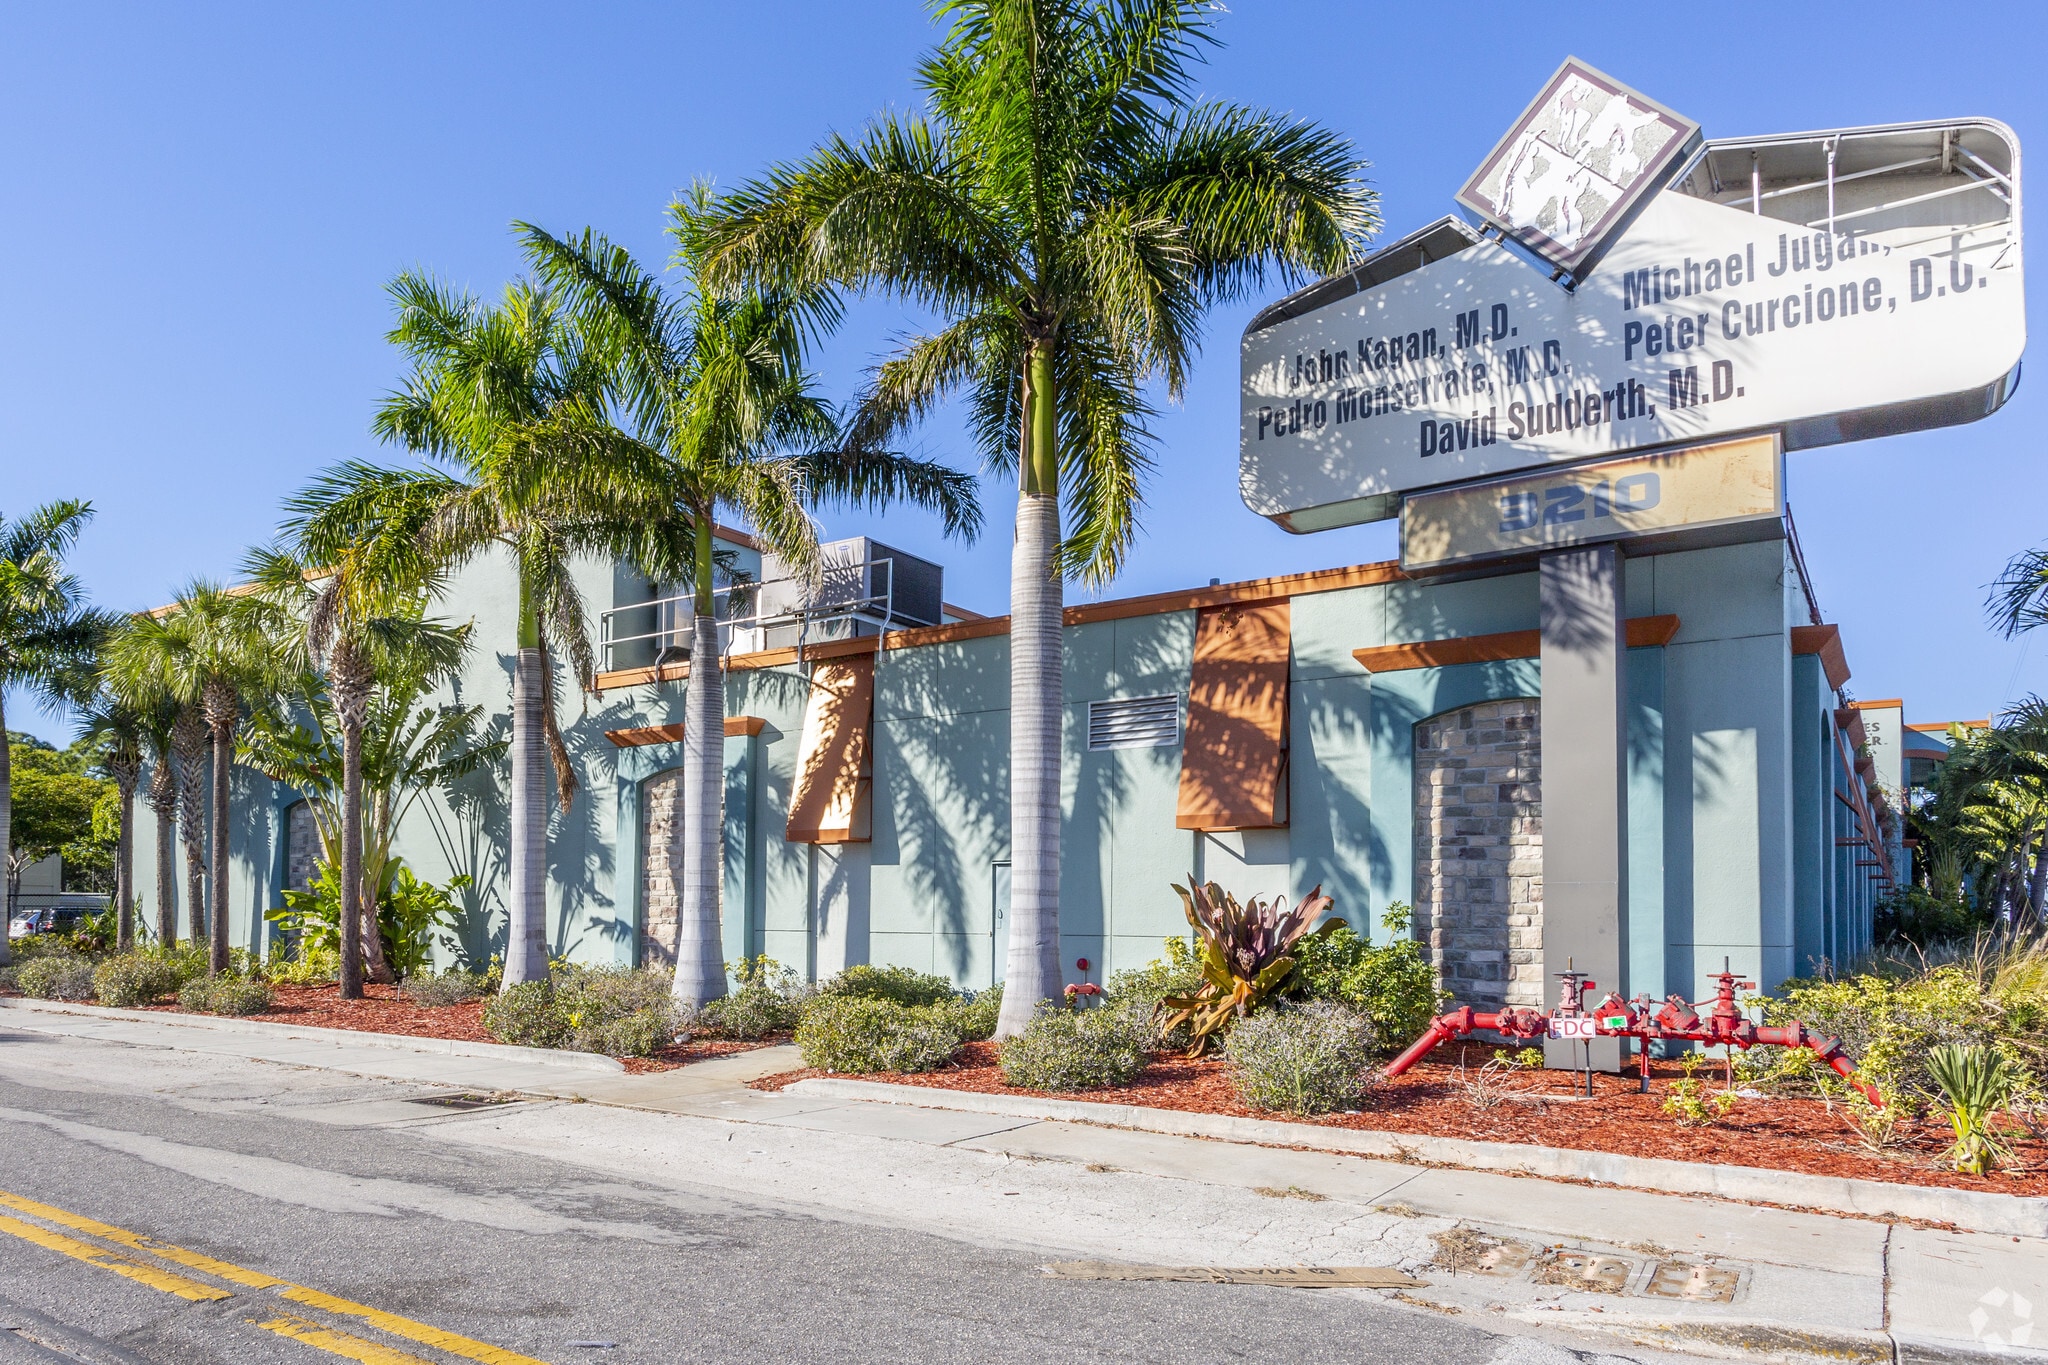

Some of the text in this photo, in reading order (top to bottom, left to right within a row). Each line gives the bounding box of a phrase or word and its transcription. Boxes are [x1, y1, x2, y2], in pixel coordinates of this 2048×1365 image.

[1623, 242, 1755, 311] Michael
[1624, 312, 1710, 362] Peter
[1721, 273, 1896, 341] Curcione,
[1258, 339, 1571, 441] Pedro Monserrate, M.D.
[1289, 302, 1518, 390] John Kagan, M.D.
[1420, 359, 1745, 459] David Sudderth, M.D.
[1498, 472, 1661, 534] 3210
[1551, 1019, 1594, 1036] FDC
